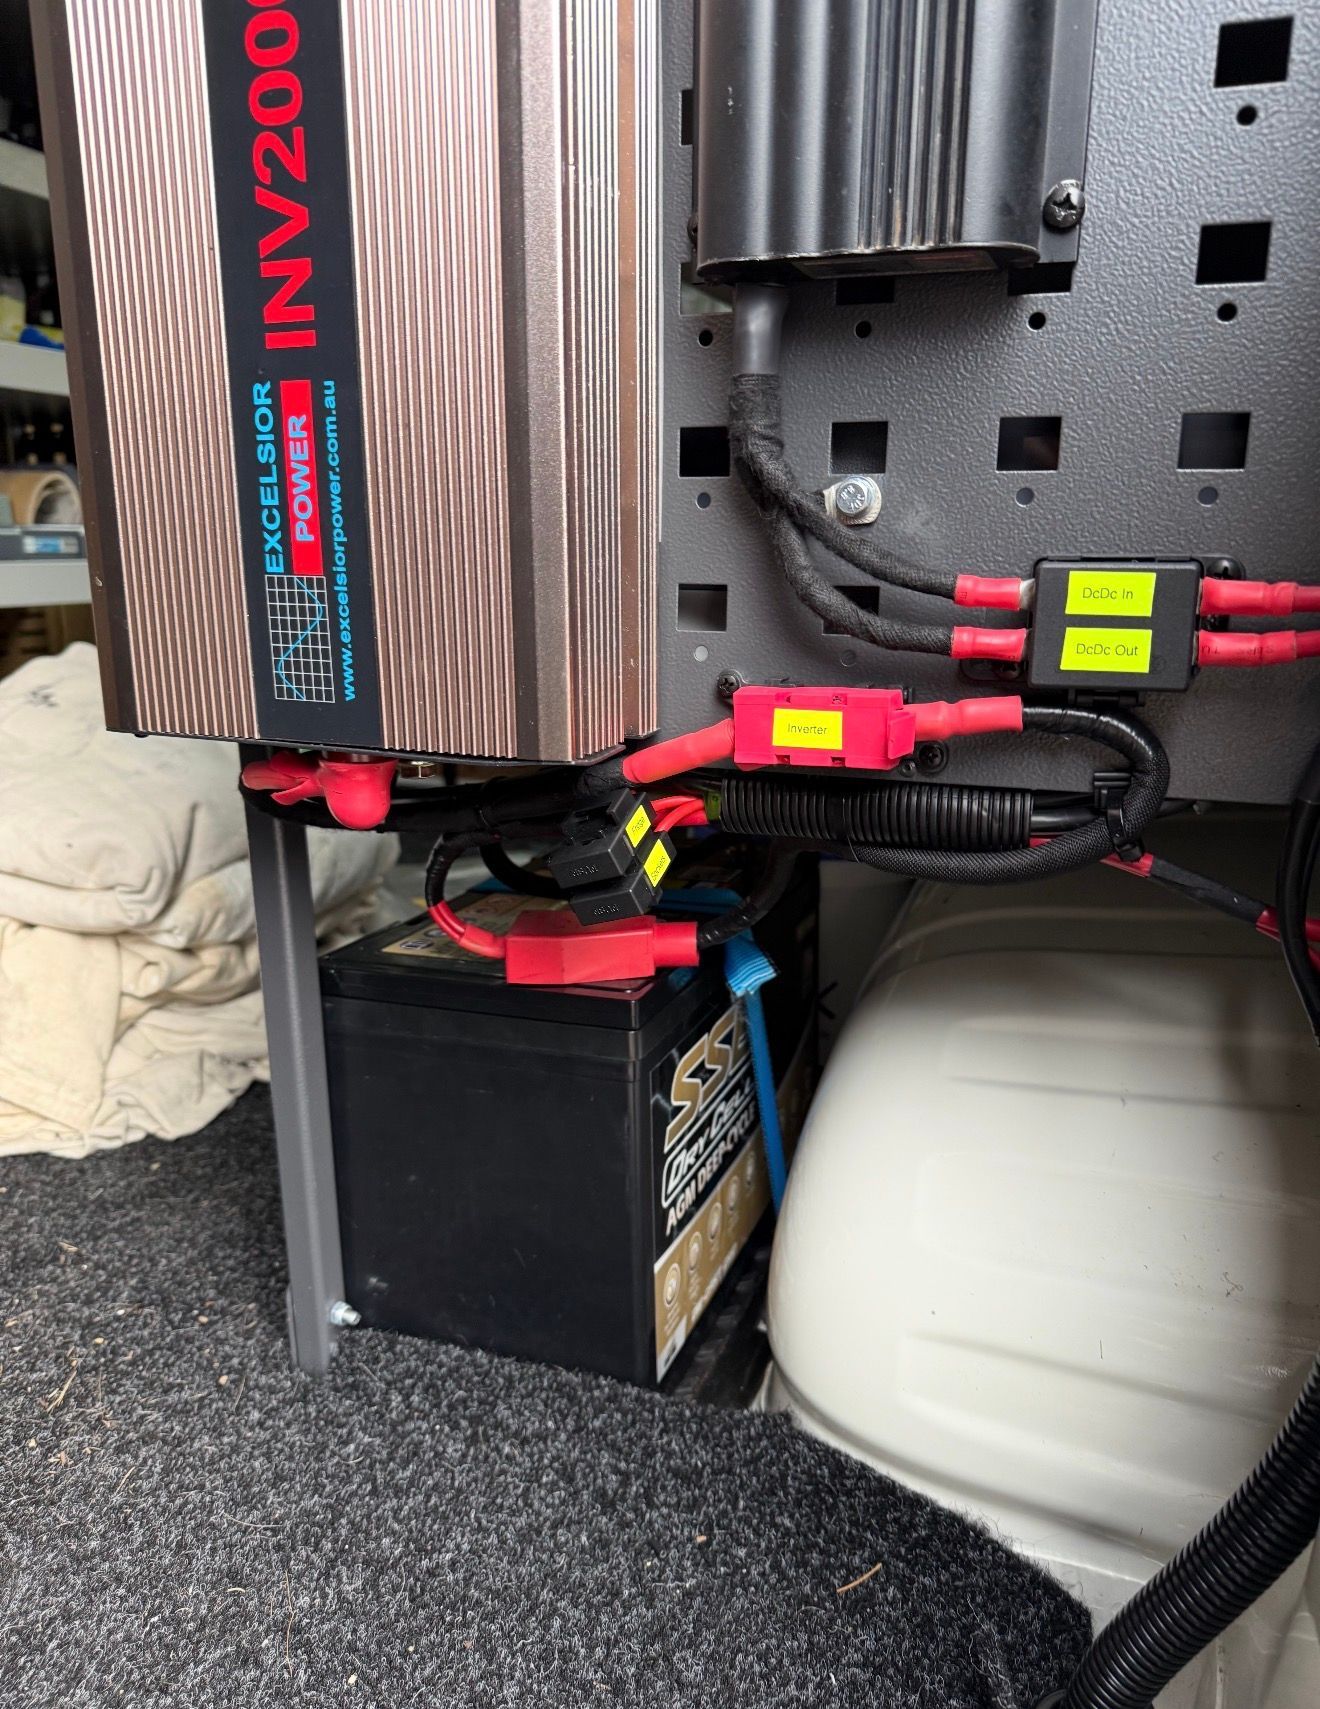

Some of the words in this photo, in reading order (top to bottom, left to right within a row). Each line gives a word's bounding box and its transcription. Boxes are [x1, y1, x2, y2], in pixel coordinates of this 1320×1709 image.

[245, 0, 317, 349] INV200
[253, 380, 285, 574] EXCELSIOR
[287, 414, 314, 543] POWER
[323, 379, 356, 702] www.excelsiorpower.com.au
[1082, 587, 1117, 600] DcDc
[1122, 588, 1134, 600] In
[1076, 643, 1111, 656] DcDc
[1115, 643, 1138, 656] Out
[787, 723, 827, 735] Inverter
[666, 1182, 696, 1236] AGM
